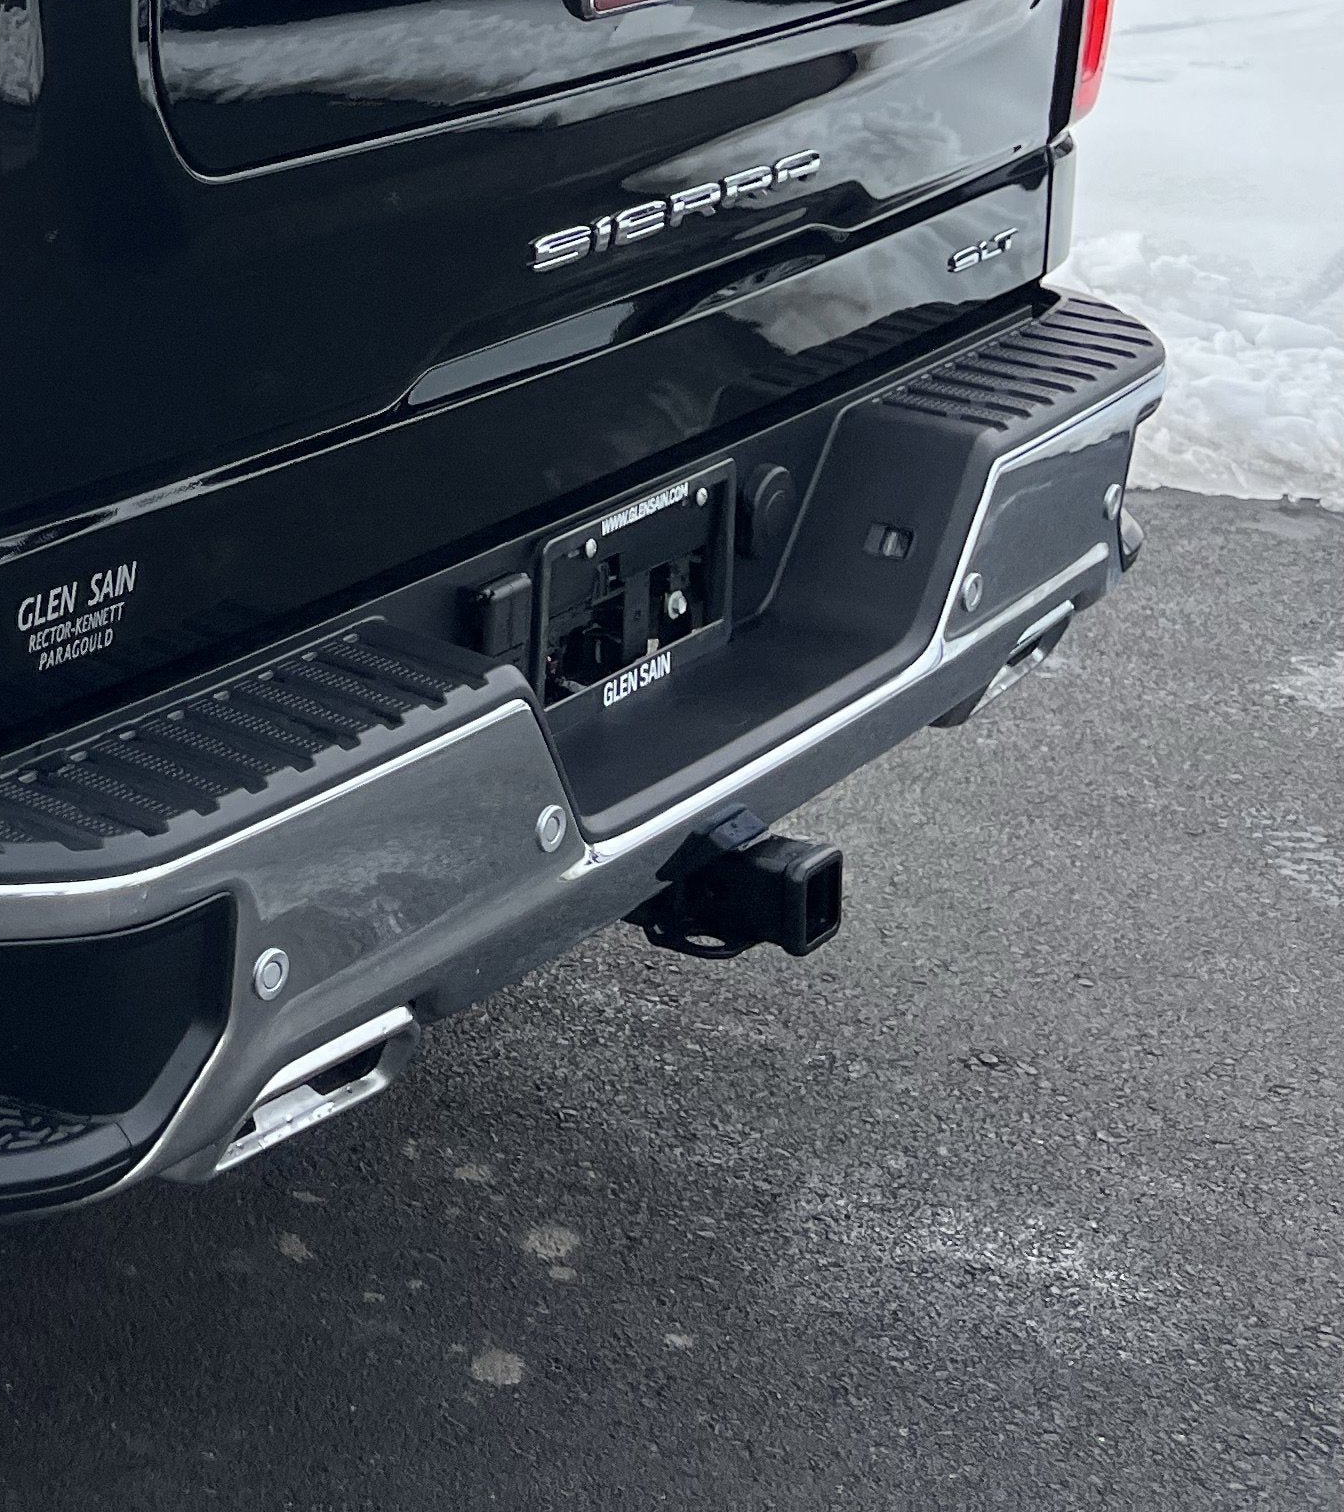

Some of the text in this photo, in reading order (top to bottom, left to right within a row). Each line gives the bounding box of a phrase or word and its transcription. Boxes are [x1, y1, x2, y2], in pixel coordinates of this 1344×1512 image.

[527, 148, 822, 273] SIERRA
[946, 226, 1020, 273] SLT
[17, 560, 138, 632] GLEN SAIN
[28, 601, 126, 654] RECTOR-KENNETT
[38, 628, 114, 671] PARAGOULD
[602, 651, 672, 708] GLEN SAIN
